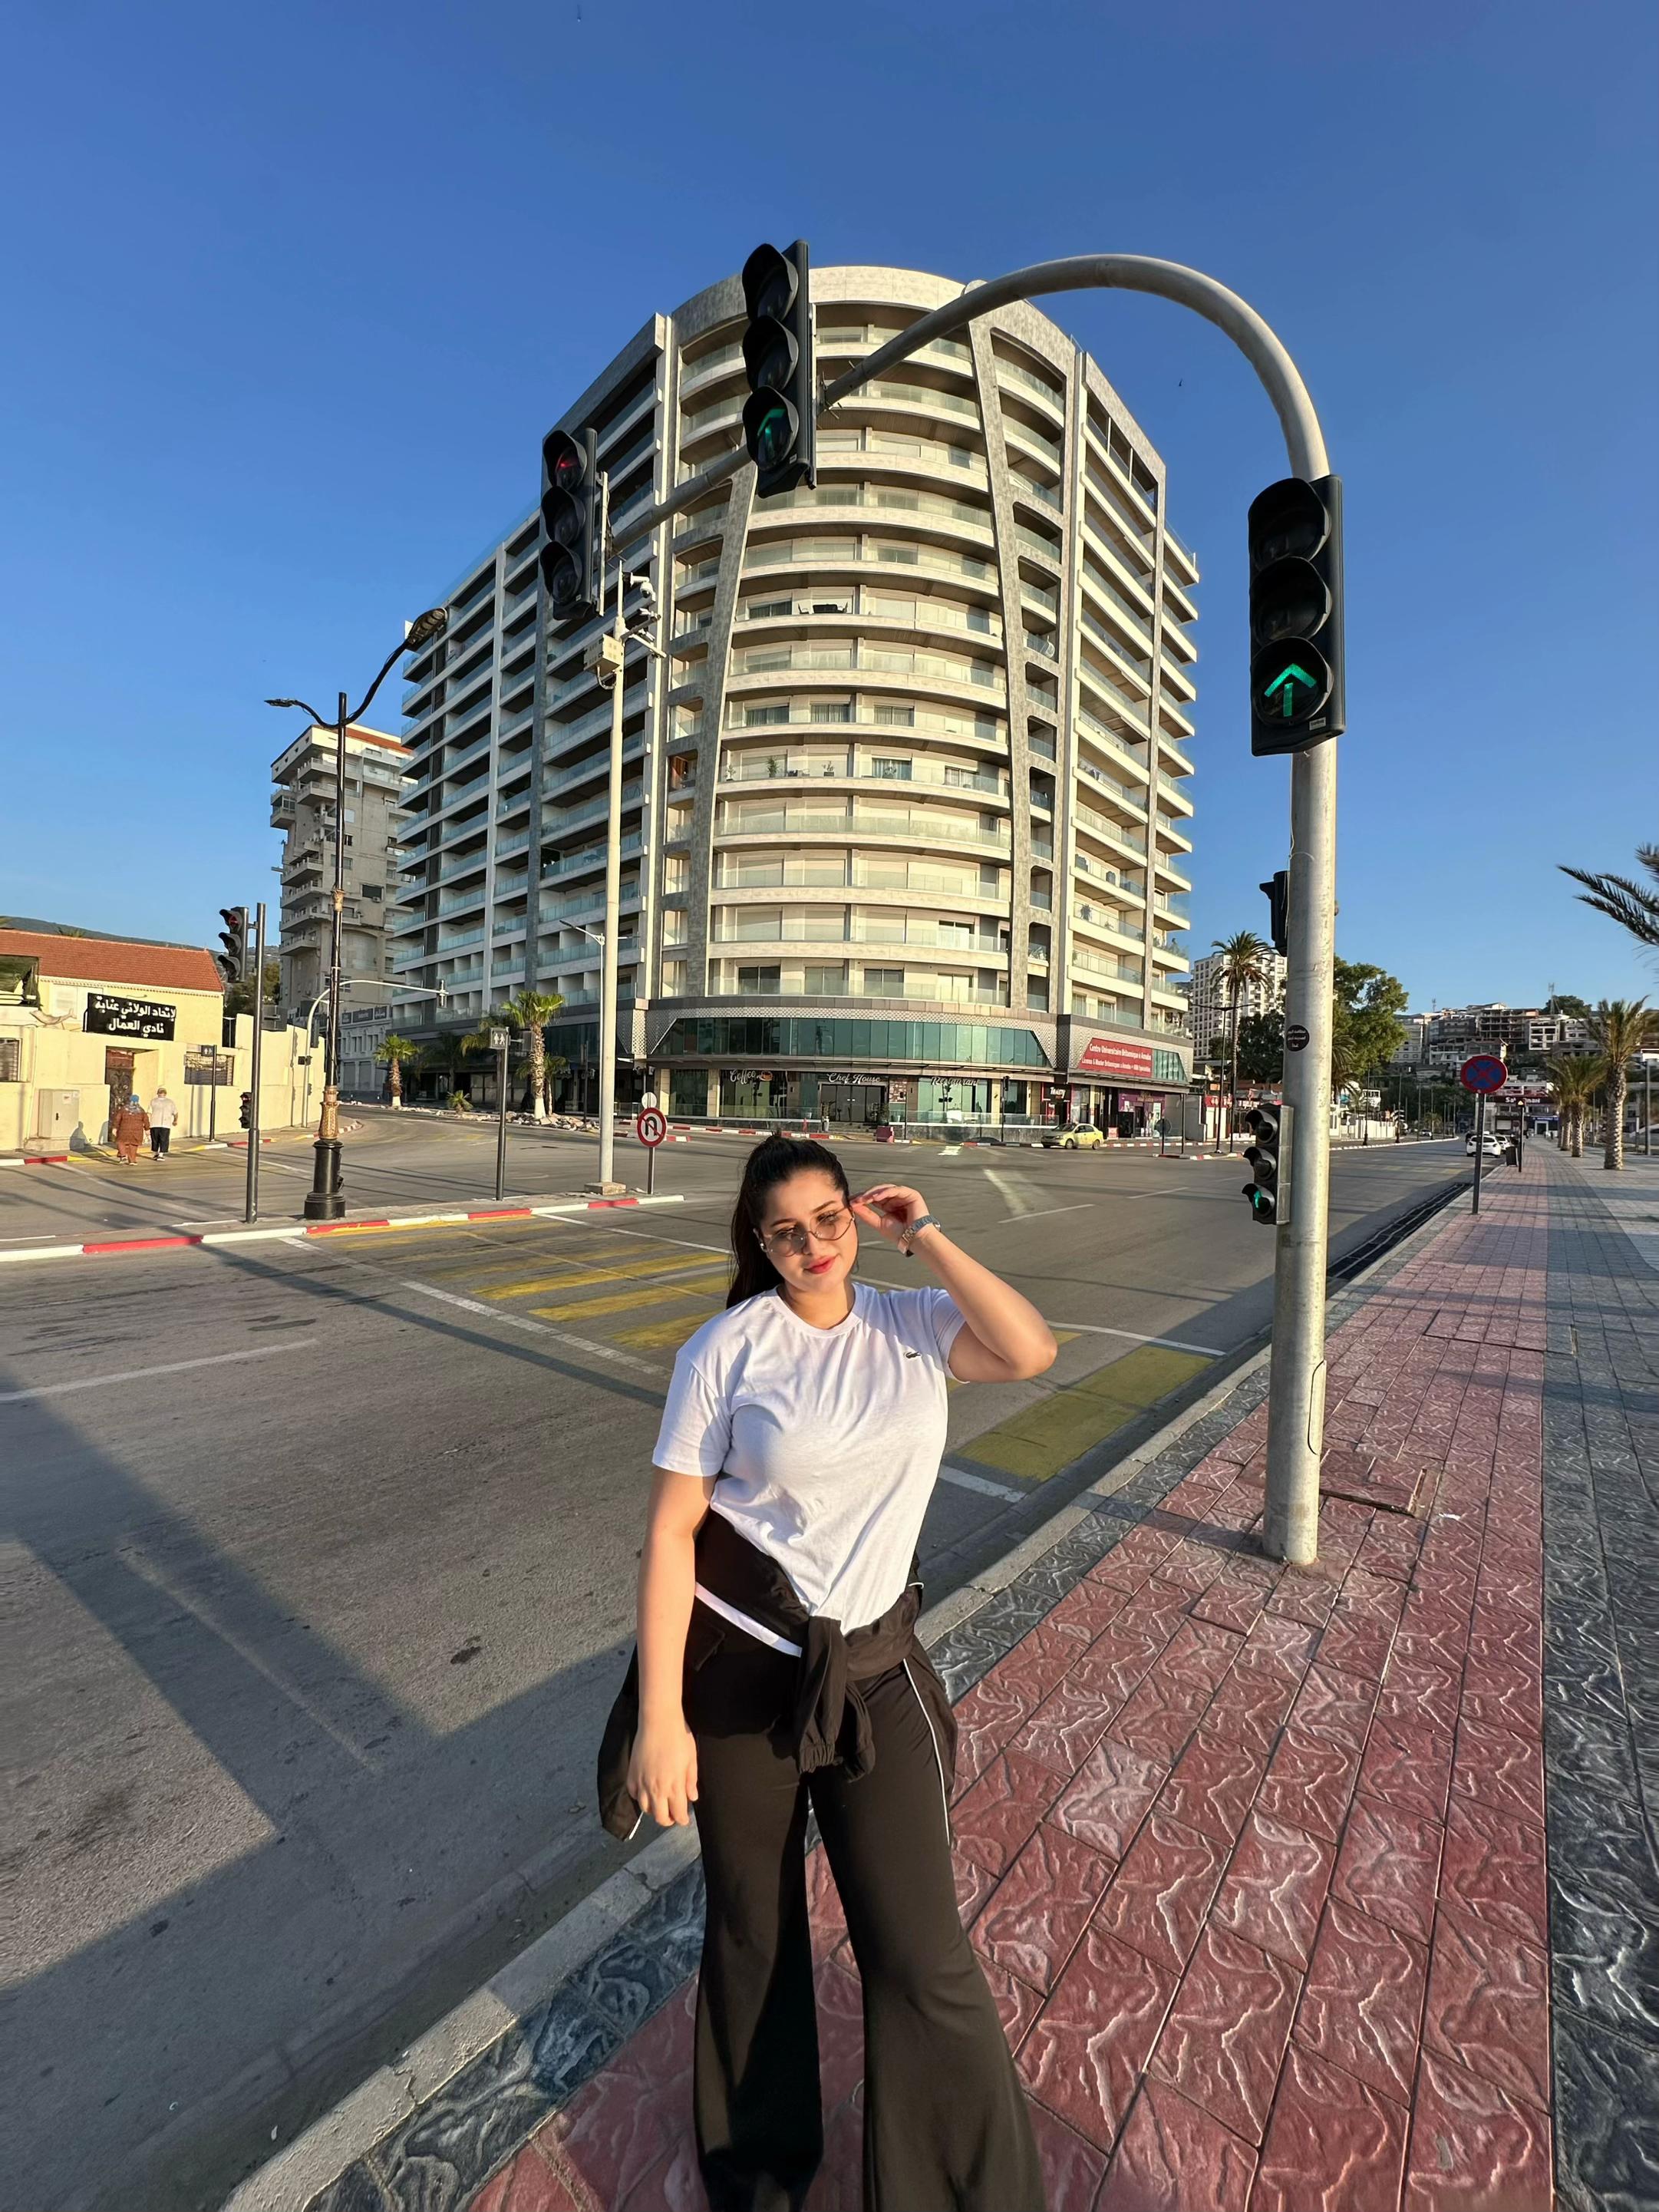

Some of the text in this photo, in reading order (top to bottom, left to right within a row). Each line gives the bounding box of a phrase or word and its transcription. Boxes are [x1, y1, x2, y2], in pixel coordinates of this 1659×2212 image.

[94, 995, 119, 1013] عنابة
[108, 1018, 164, 1038] نادي العمال
[730, 1068, 756, 1085] Coffee
[826, 1072, 882, 1085] Chef House
